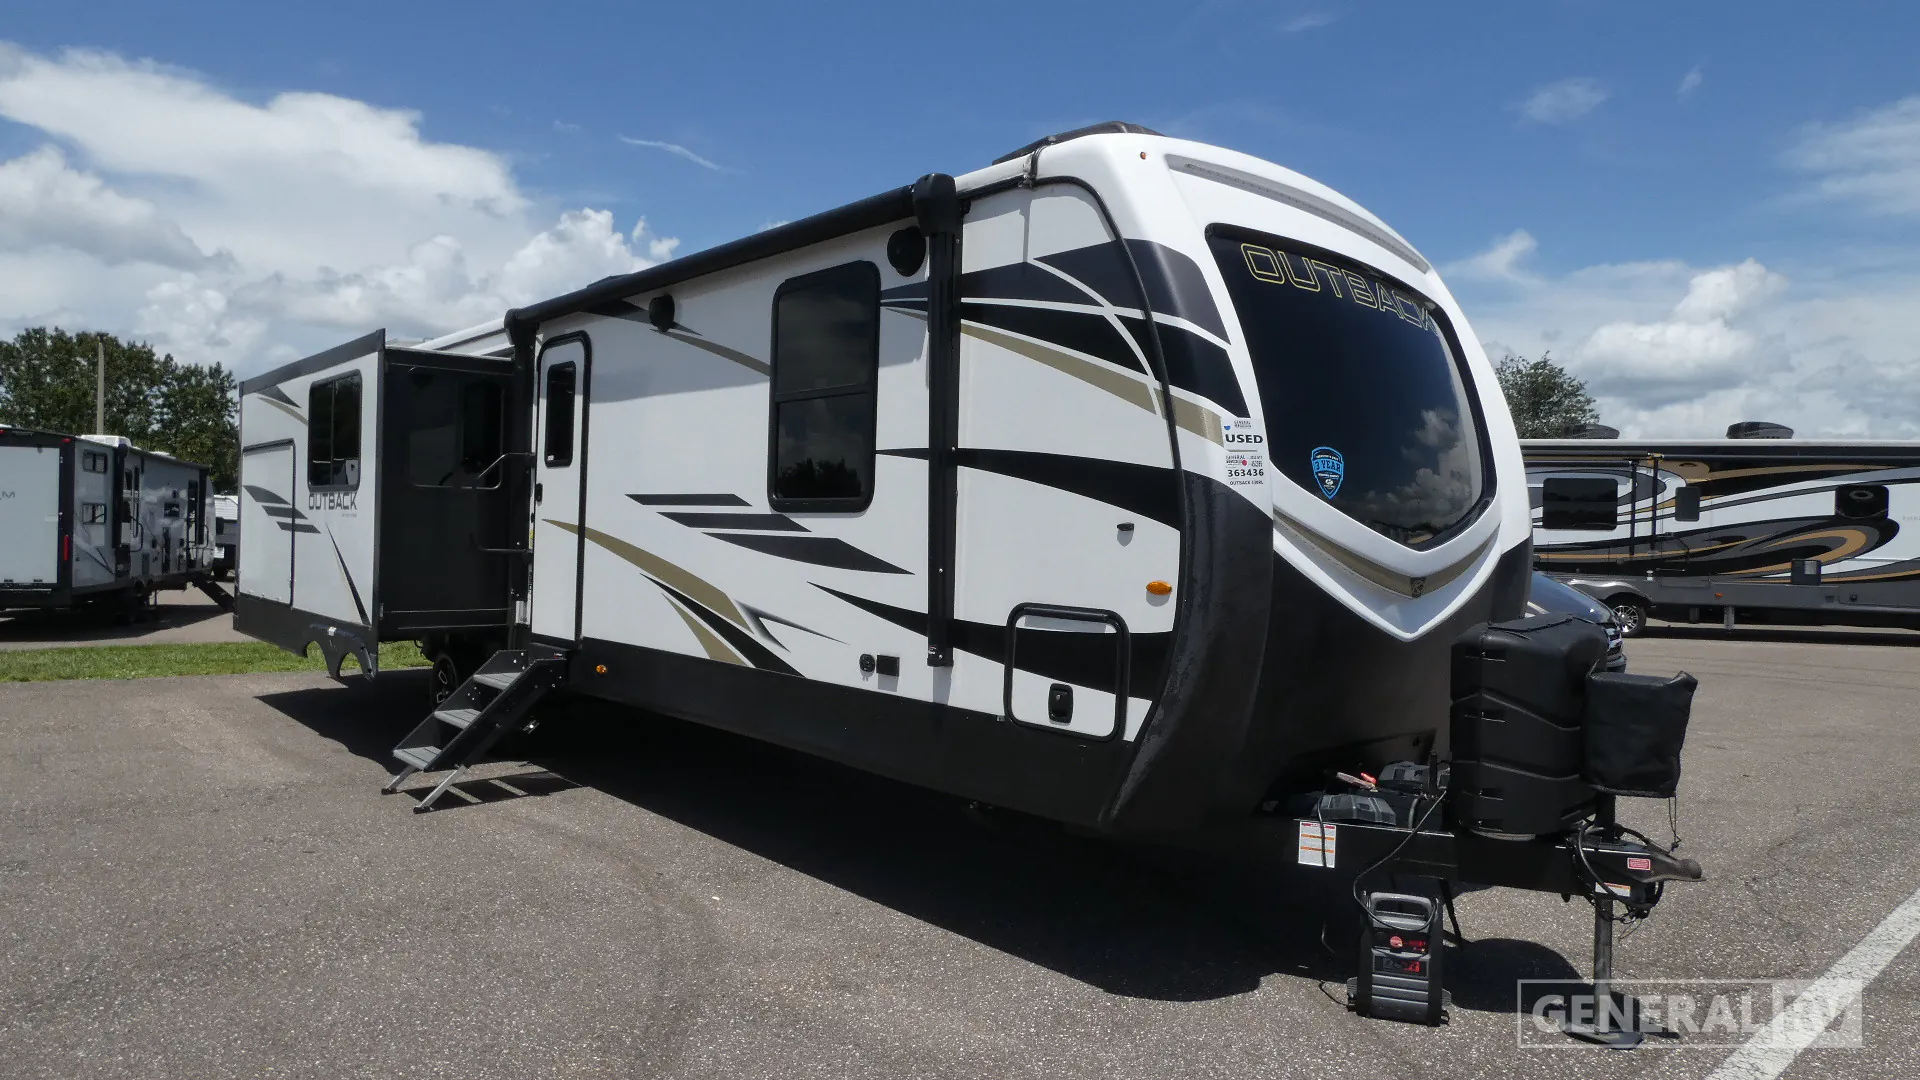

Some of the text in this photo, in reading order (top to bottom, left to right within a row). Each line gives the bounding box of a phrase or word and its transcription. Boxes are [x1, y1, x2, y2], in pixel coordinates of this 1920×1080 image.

[1241, 243, 1439, 337] OUTBACK
[1225, 434, 1263, 443] USED
[1227, 468, 1264, 477] 363436
[1314, 460, 1341, 473] 3 YEAR
[308, 492, 358, 511] OUTBACK
